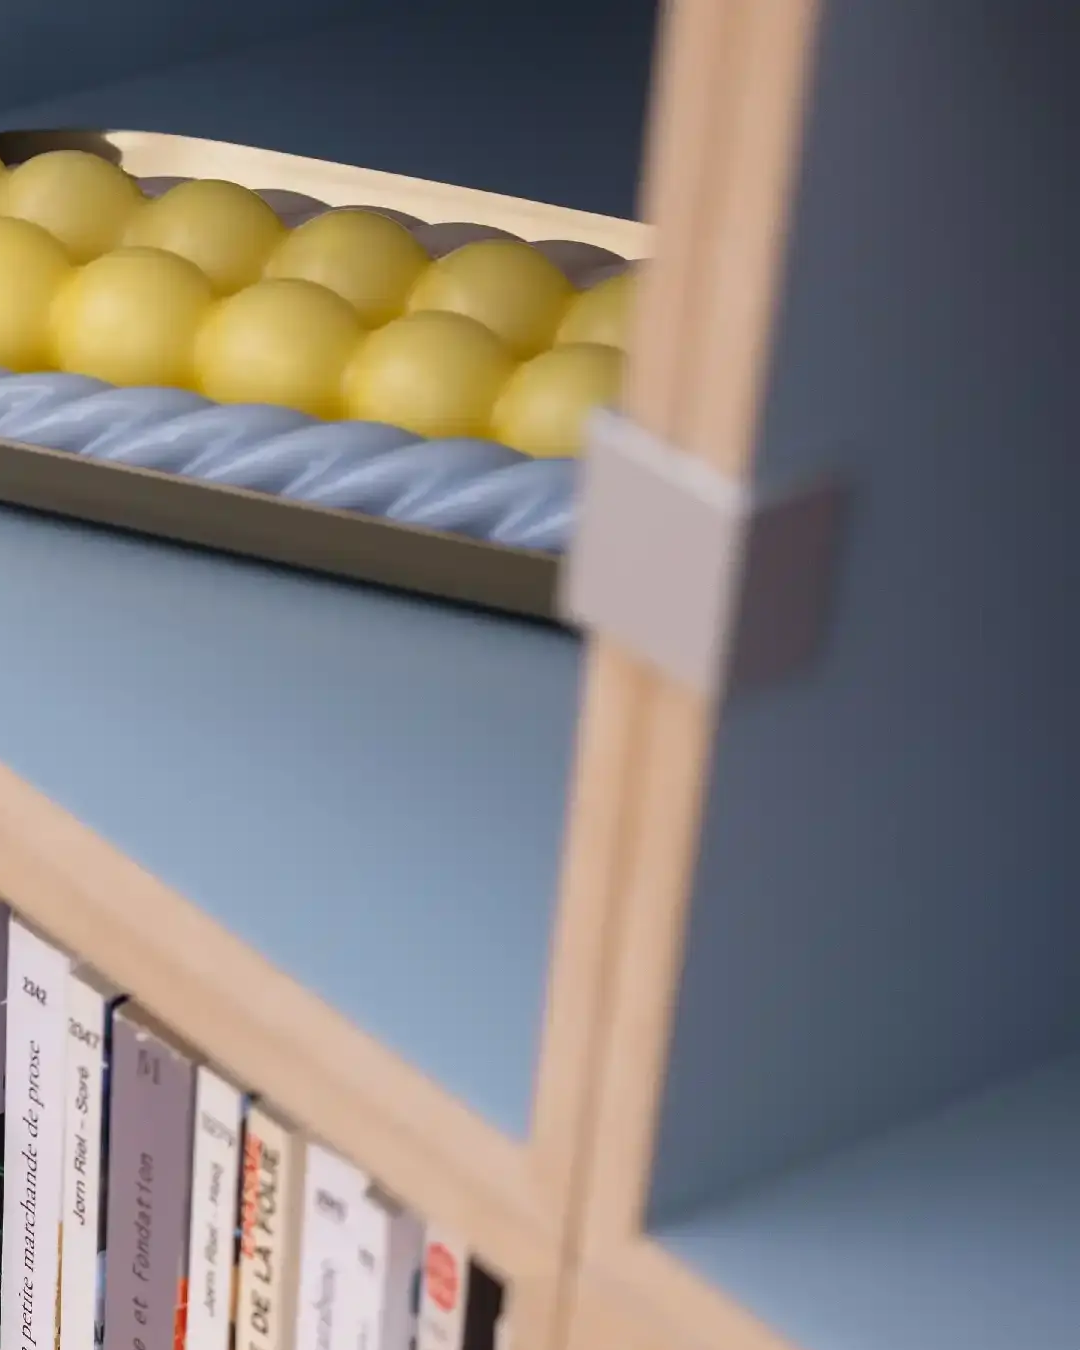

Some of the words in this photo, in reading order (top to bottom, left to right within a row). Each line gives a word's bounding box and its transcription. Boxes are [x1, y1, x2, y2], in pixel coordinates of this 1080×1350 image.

[25, 1040, 46, 1111] prose
[22, 1114, 41, 1140] de
[72, 1132, 88, 1178] Riel
[19, 1145, 40, 1277] marchande
[132, 1152, 154, 1282] Fondation
[255, 1244, 273, 1288] LA
[18, 1278, 38, 1345] petite
[132, 1296, 150, 1327] et
[251, 1289, 268, 1337] DE
